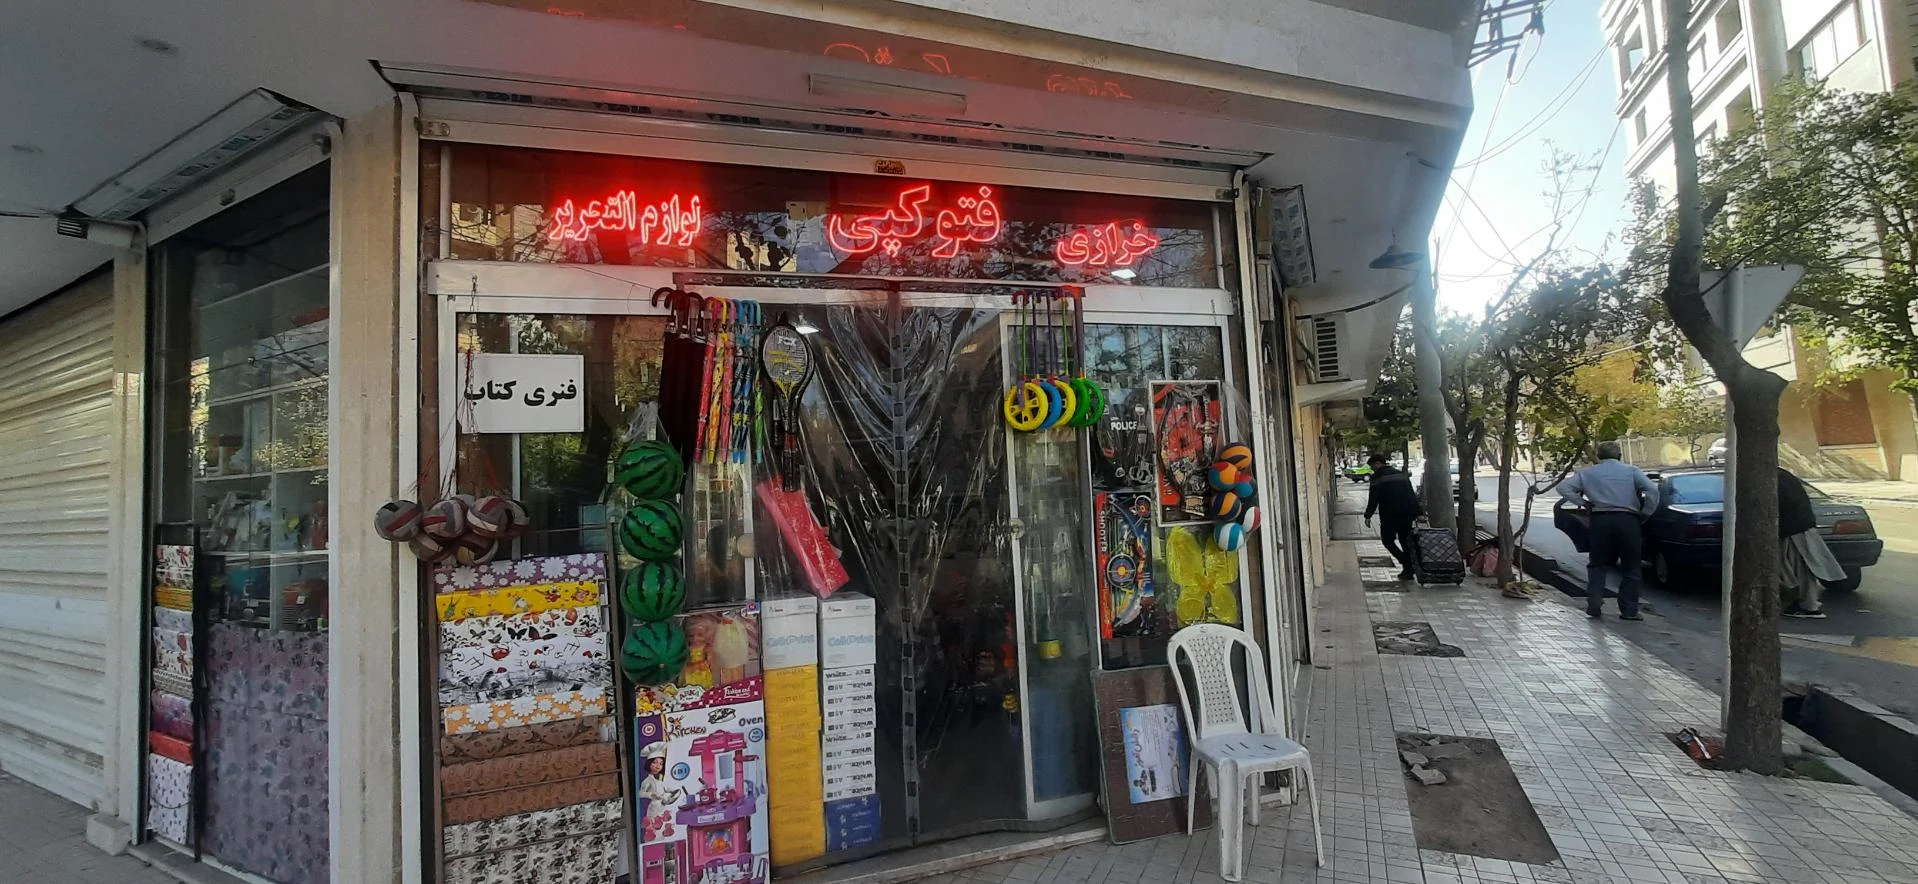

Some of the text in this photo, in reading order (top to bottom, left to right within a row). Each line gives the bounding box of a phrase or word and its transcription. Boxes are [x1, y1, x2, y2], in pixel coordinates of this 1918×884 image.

[549, 189, 701, 247] لوازم التحریر
[829, 184, 1001, 258] فتو کپی
[1057, 221, 1158, 266] خرازی
[463, 378, 578, 407] فنری کتاب
[1110, 420, 1138, 431] POLICE
[1099, 510, 1108, 553] SHOOTER
[738, 716, 763, 727] Oven
